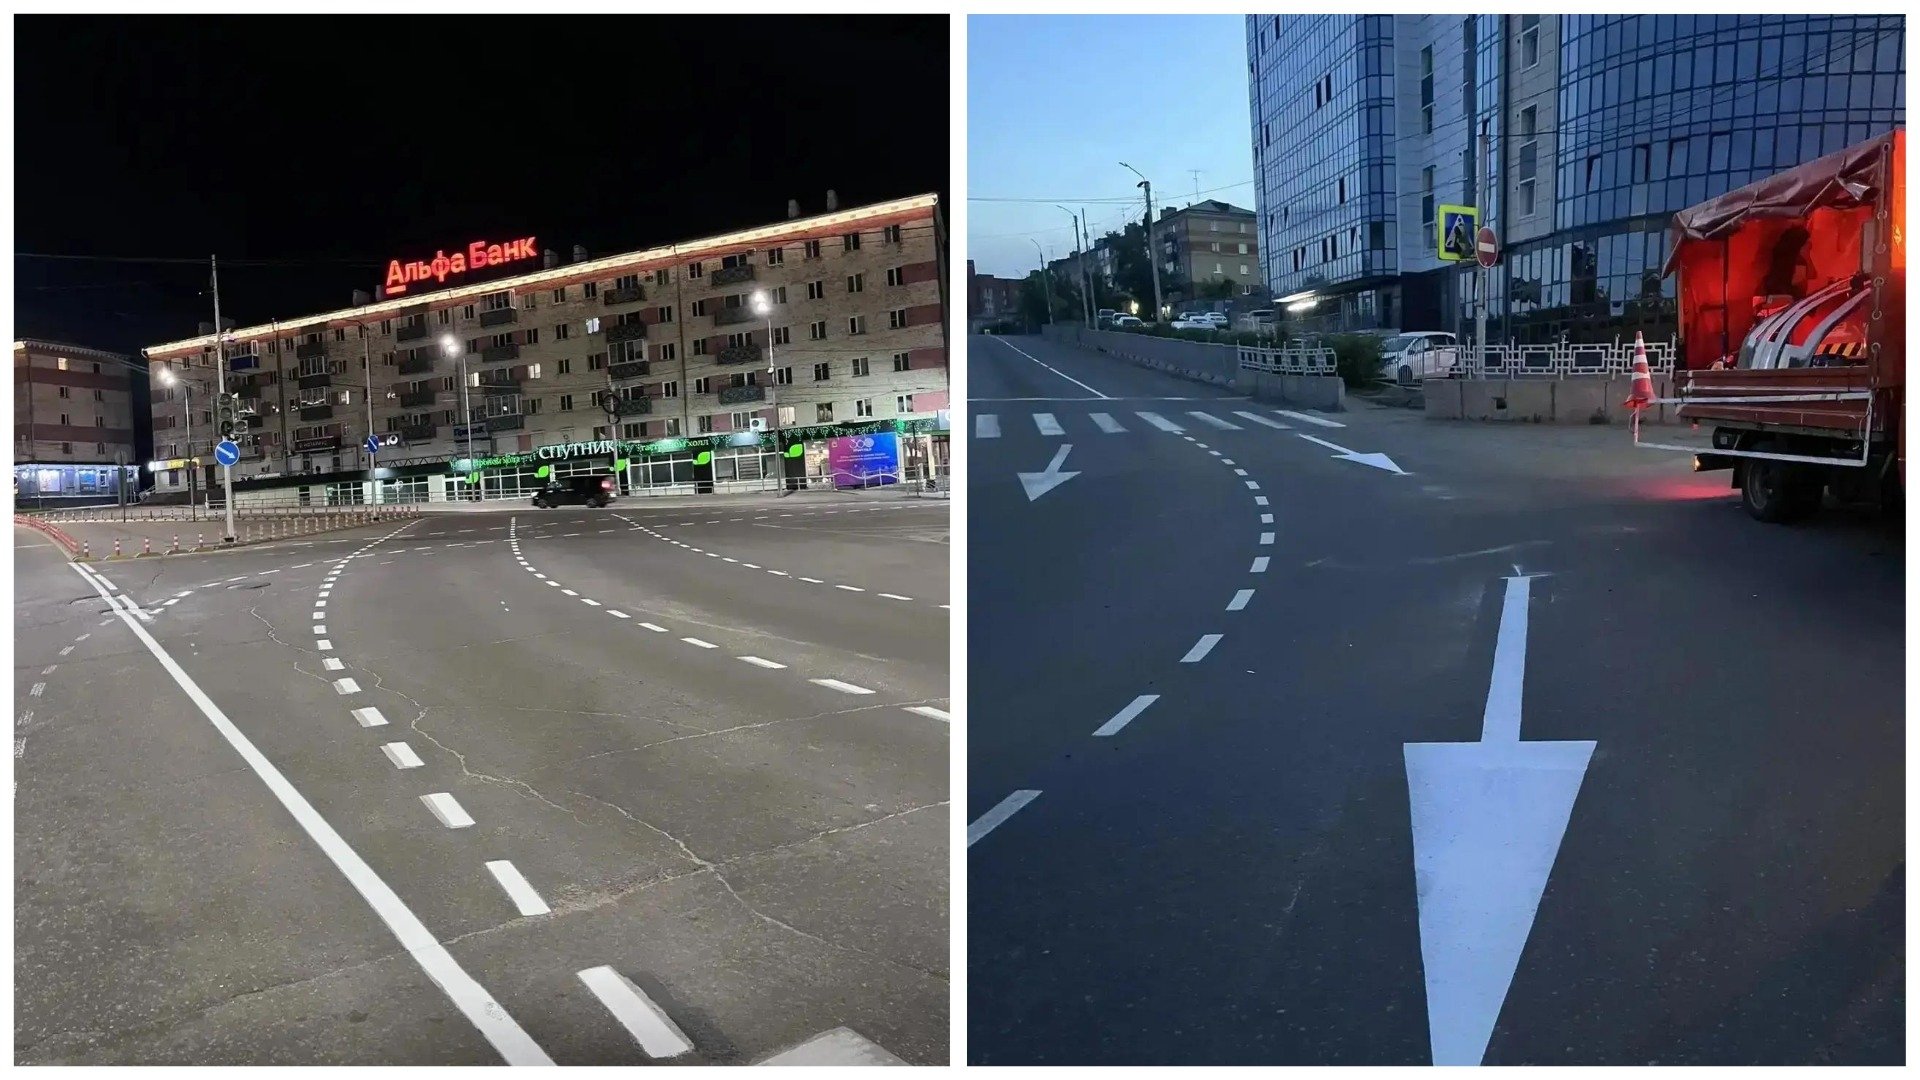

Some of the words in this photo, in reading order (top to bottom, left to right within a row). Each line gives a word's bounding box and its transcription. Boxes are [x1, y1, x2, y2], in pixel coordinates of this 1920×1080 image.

[386, 250, 467, 289] Альфа
[469, 236, 538, 269] Банк
[538, 440, 615, 460] СПУТНИК
